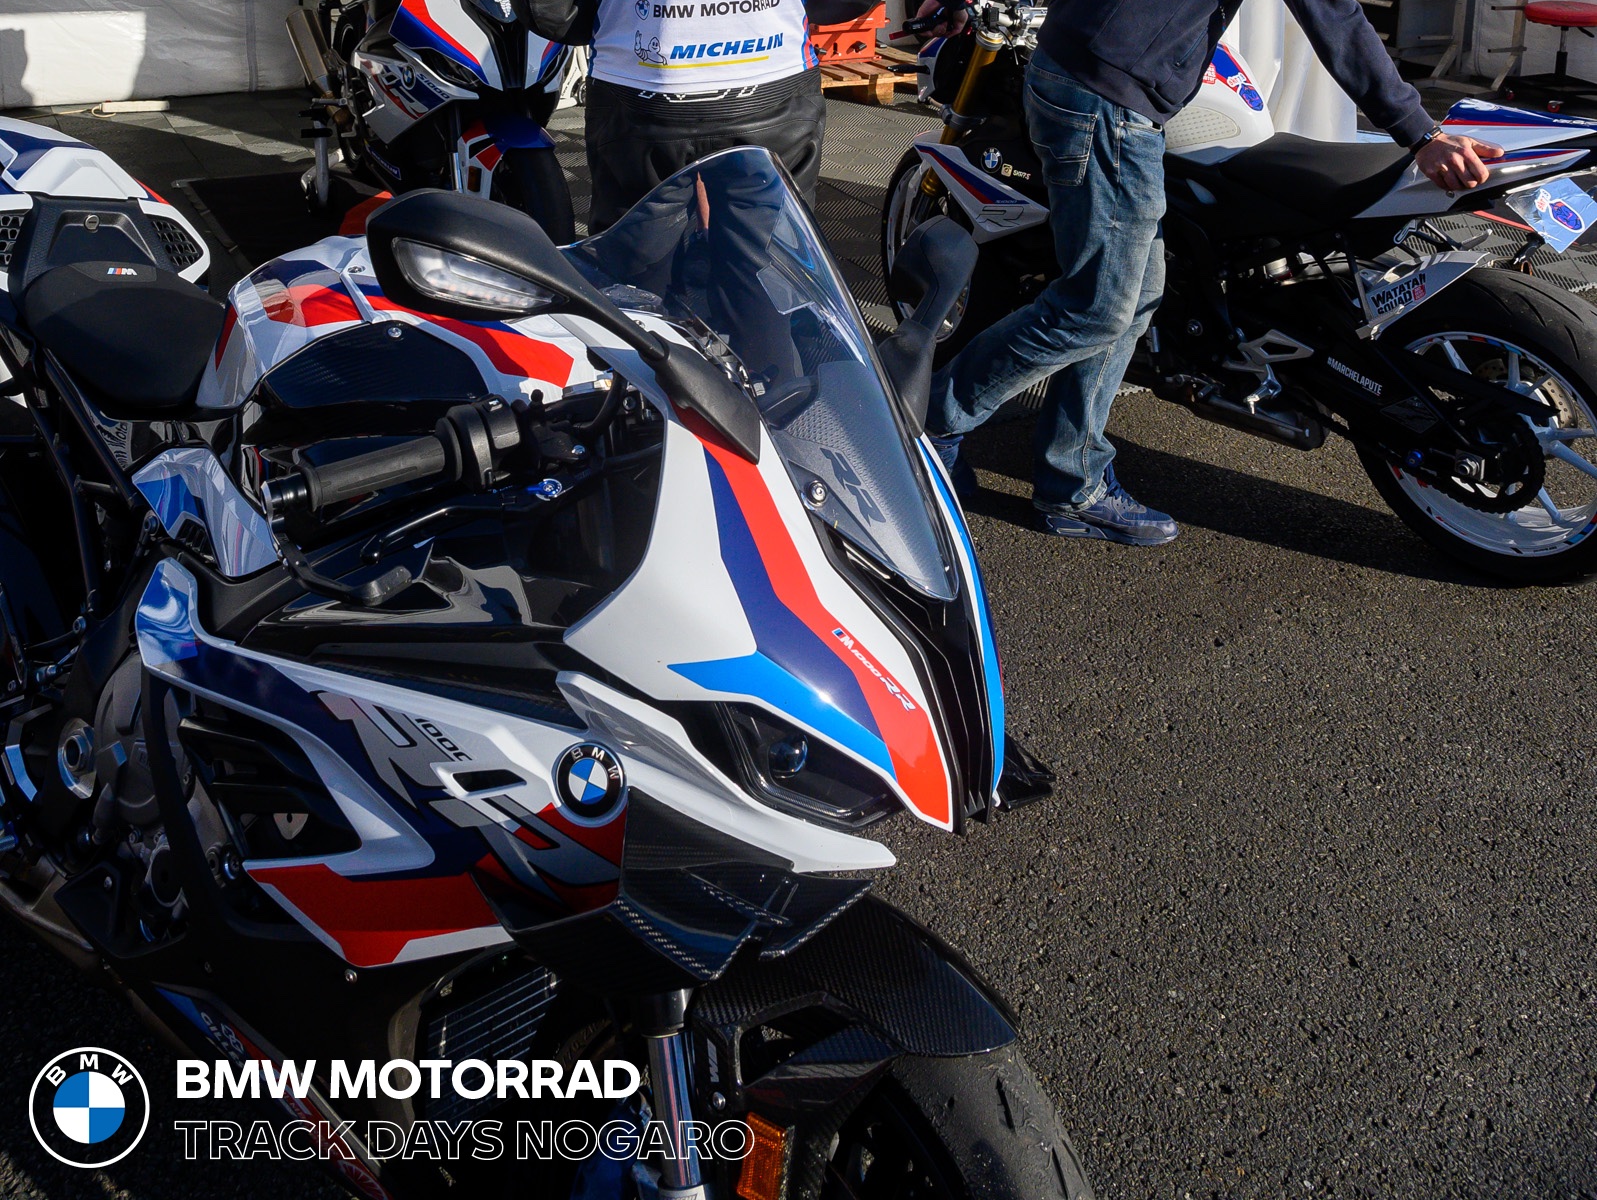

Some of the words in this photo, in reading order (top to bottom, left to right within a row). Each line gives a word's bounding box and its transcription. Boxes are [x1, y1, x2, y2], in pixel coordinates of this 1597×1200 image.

[653, 4, 695, 19] BMW
[670, 32, 784, 60] MICHELIN
[416, 73, 451, 100] S1000
[1327, 356, 1383, 395] #MARCHELAPUTE
[572, 746, 620, 780] BMW
